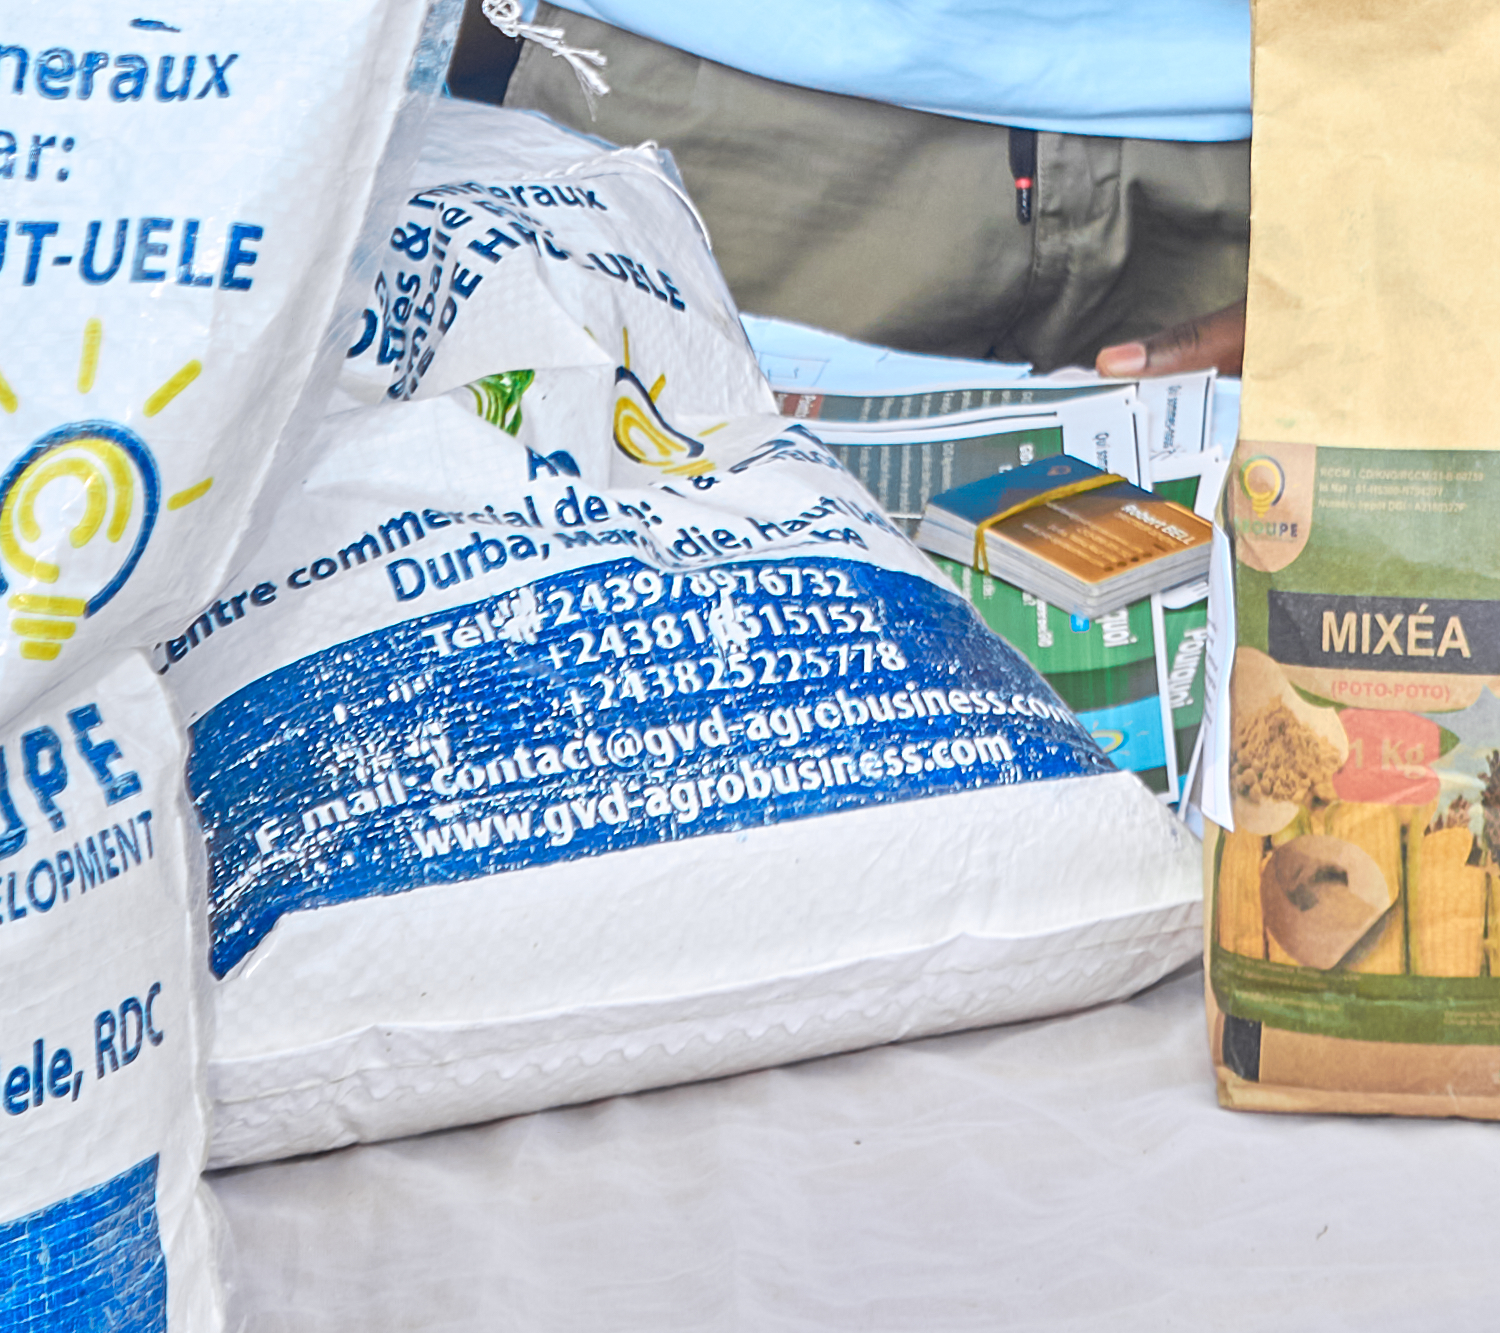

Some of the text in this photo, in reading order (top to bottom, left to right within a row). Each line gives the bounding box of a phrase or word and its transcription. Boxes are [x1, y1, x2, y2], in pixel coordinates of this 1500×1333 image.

[152, 581, 278, 676] entre
[553, 484, 610, 530] de
[386, 527, 550, 602] Durba,
[1320, 603, 1473, 659] MIXÉA
[1330, 679, 1451, 702] (POTO-POTO)
[410, 731, 1014, 861] www.gvd-agrobusiness.com
[1381, 738, 1425, 779] Kg
[94, 980, 166, 1081] RDC
